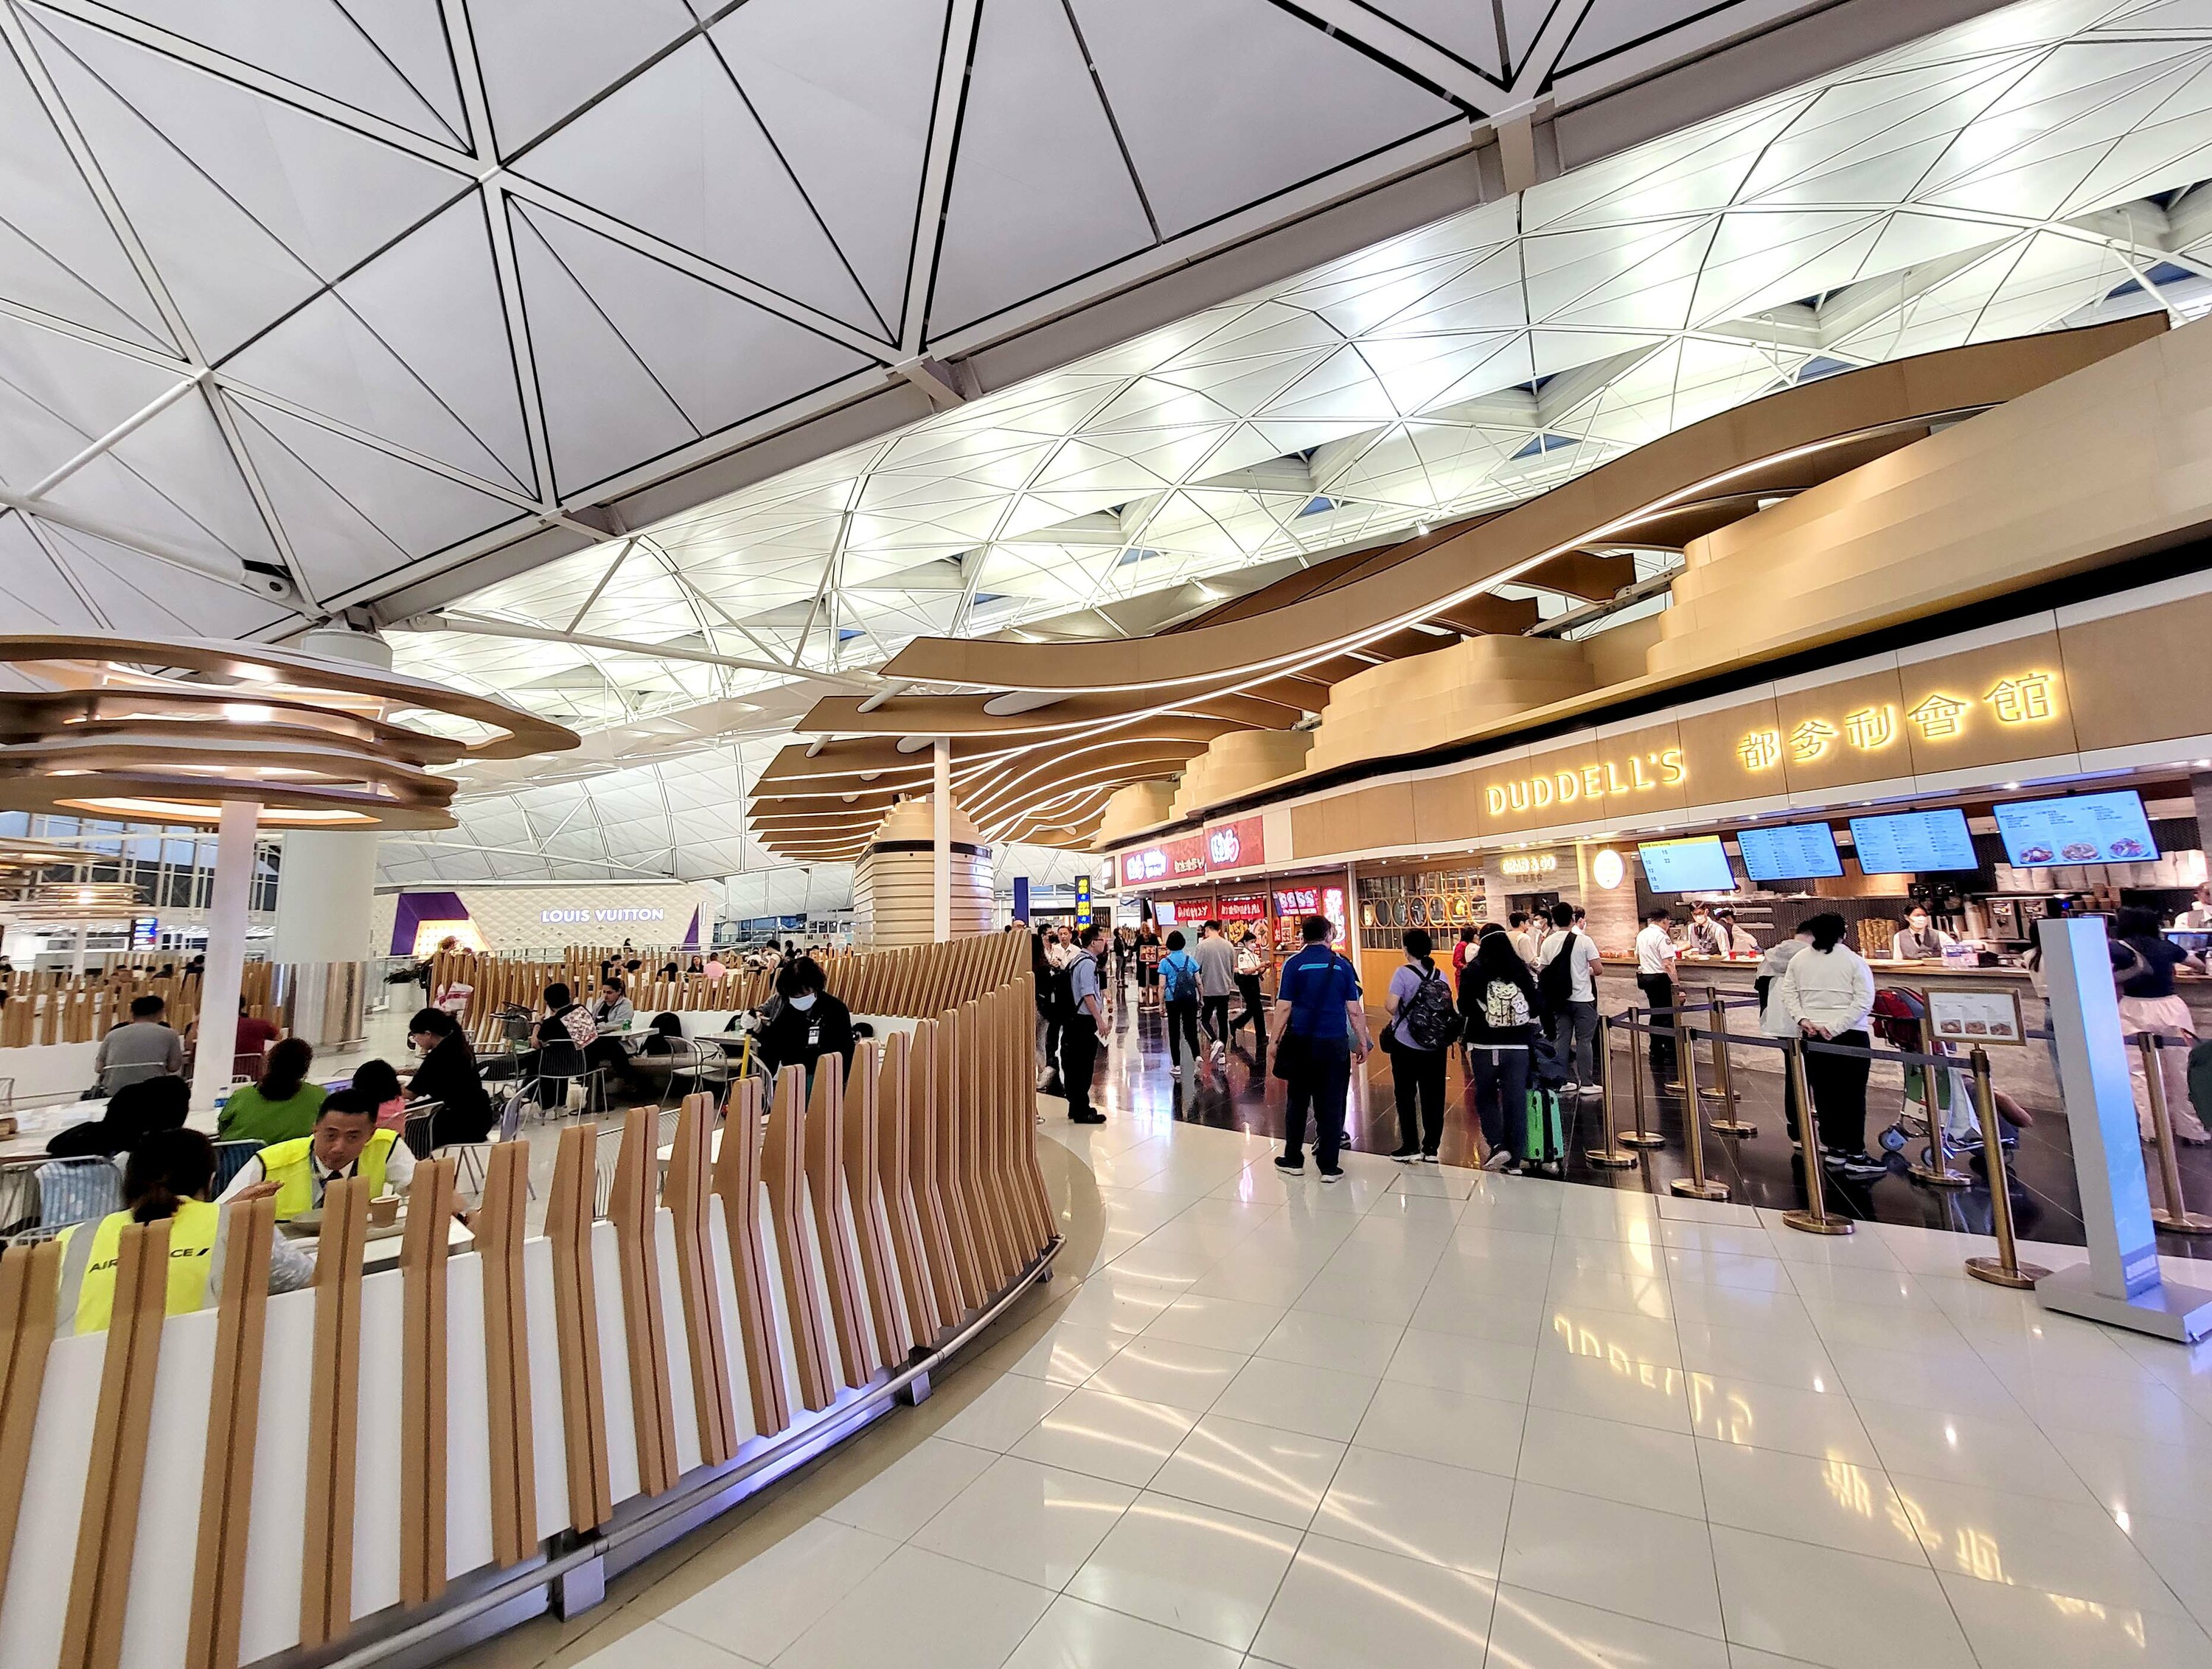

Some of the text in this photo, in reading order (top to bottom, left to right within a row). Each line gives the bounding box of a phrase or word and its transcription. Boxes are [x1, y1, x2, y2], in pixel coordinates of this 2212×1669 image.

[1737, 672, 2056, 769] 都爹利會館
[1485, 750, 1683, 815] DUDDELL'S
[1501, 857, 1554, 873] GRAB & GO
[540, 907, 664, 923] LOUIS VUITTON
